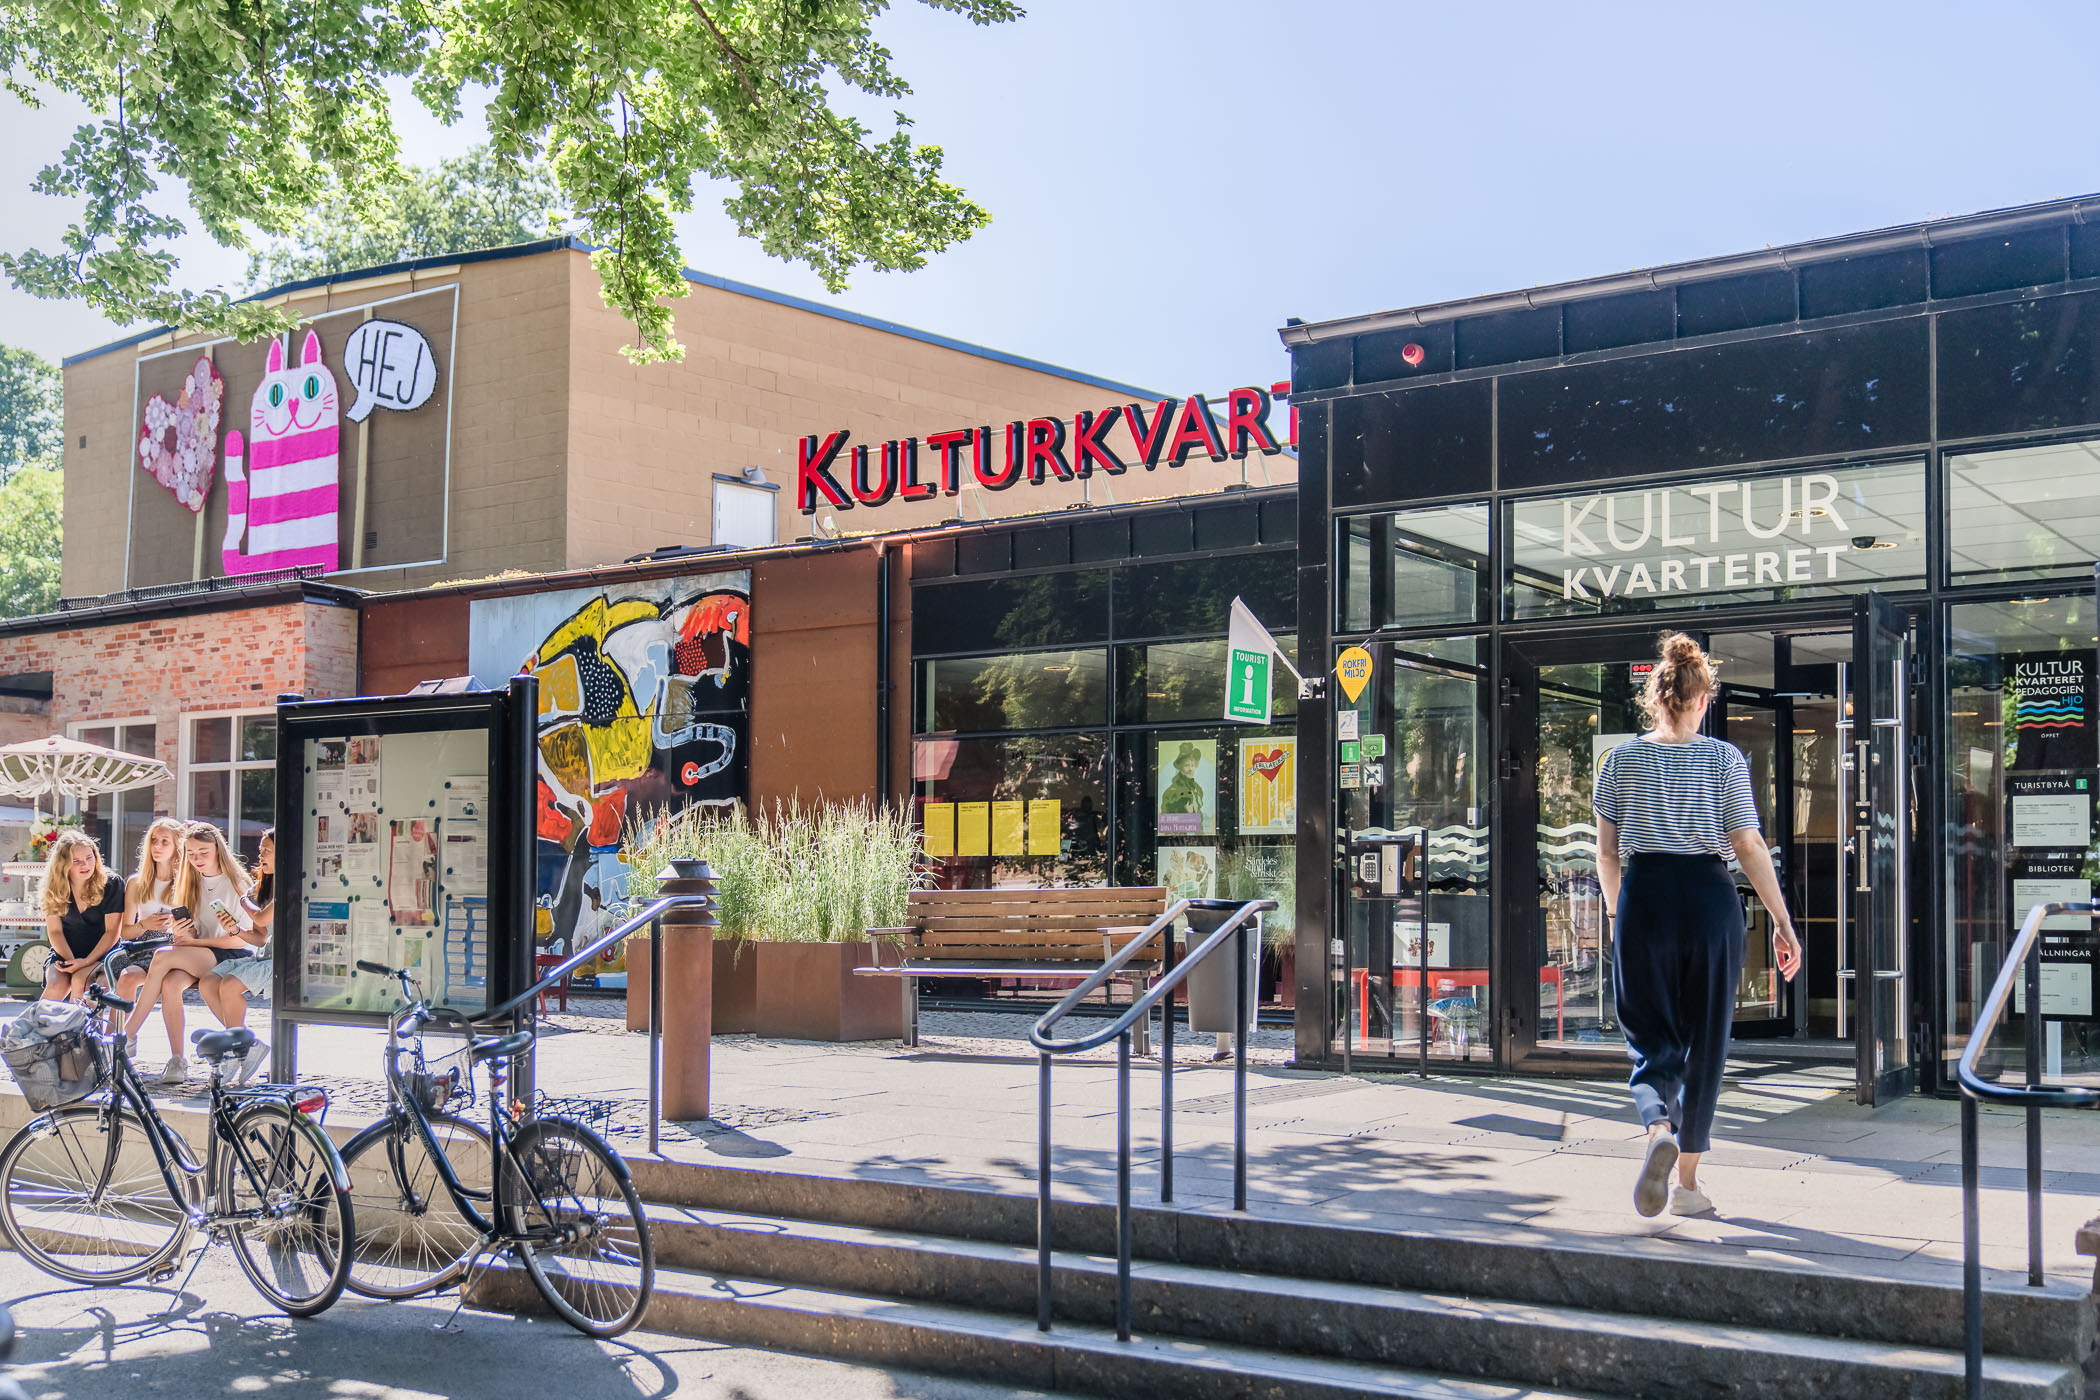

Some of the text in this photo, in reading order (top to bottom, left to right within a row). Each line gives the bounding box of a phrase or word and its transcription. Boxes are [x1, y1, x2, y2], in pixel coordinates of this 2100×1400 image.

[357, 328, 423, 405] HEJ
[1563, 474, 1849, 557] KULTUR
[1563, 544, 1848, 600] KVARTERET
[1236, 651, 1266, 664] TOURIST
[2015, 660, 2084, 677] KULTUR
[2015, 675, 2084, 687] KVARTERET
[2015, 685, 2084, 696] PEDAGOGIEN
[2062, 695, 2083, 706] HJO
[1233, 705, 1262, 716] INFORMATION
[2014, 779, 2071, 790] TURISTBYRÅ
[2028, 864, 2075, 873] BIBLIOTEK
